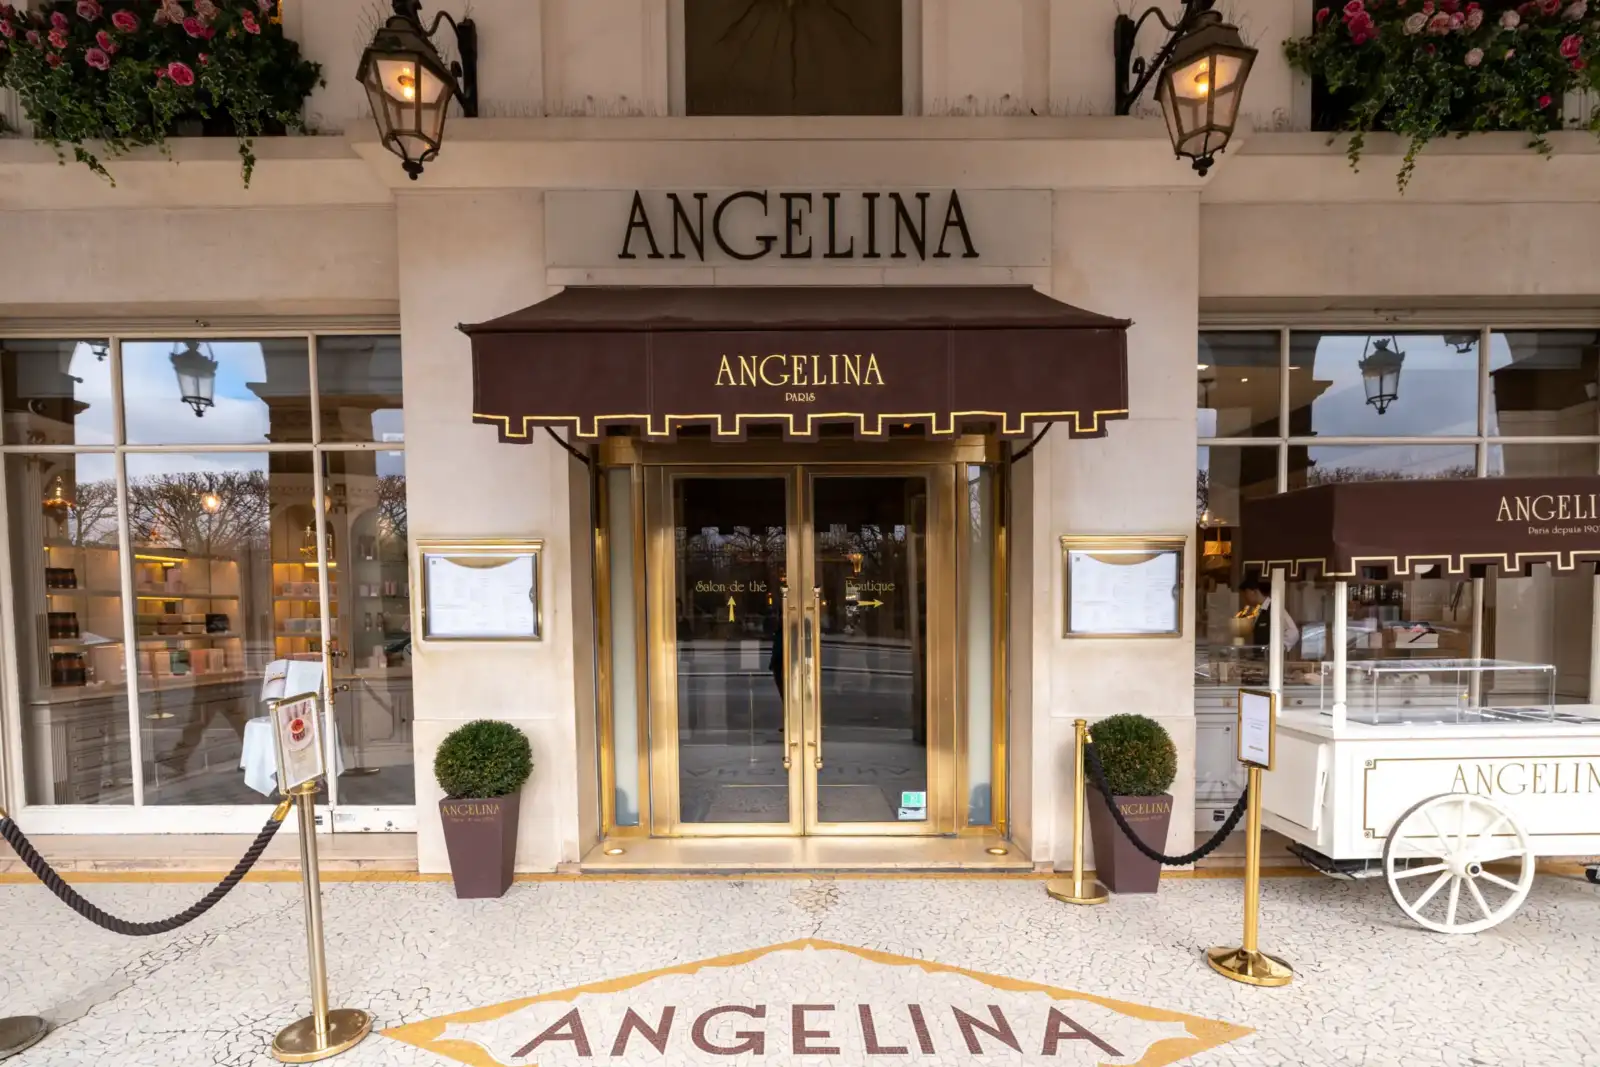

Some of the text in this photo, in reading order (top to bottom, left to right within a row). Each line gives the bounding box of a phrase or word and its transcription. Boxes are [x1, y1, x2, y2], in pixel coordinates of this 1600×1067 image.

[618, 188, 980, 262] ANGELINA
[715, 353, 885, 387] ANGELINA
[785, 392, 816, 402] PARIS
[1496, 494, 1600, 522] ANGELI
[1528, 525, 1600, 536] Paris depuis 190
[695, 580, 726, 592] Salon
[729, 580, 745, 592] de
[845, 580, 896, 596] Boutique
[442, 803, 500, 816] ANGELINA
[1116, 801, 1171, 815] NGELINA
[510, 1004, 1125, 1057] ANGELINA
